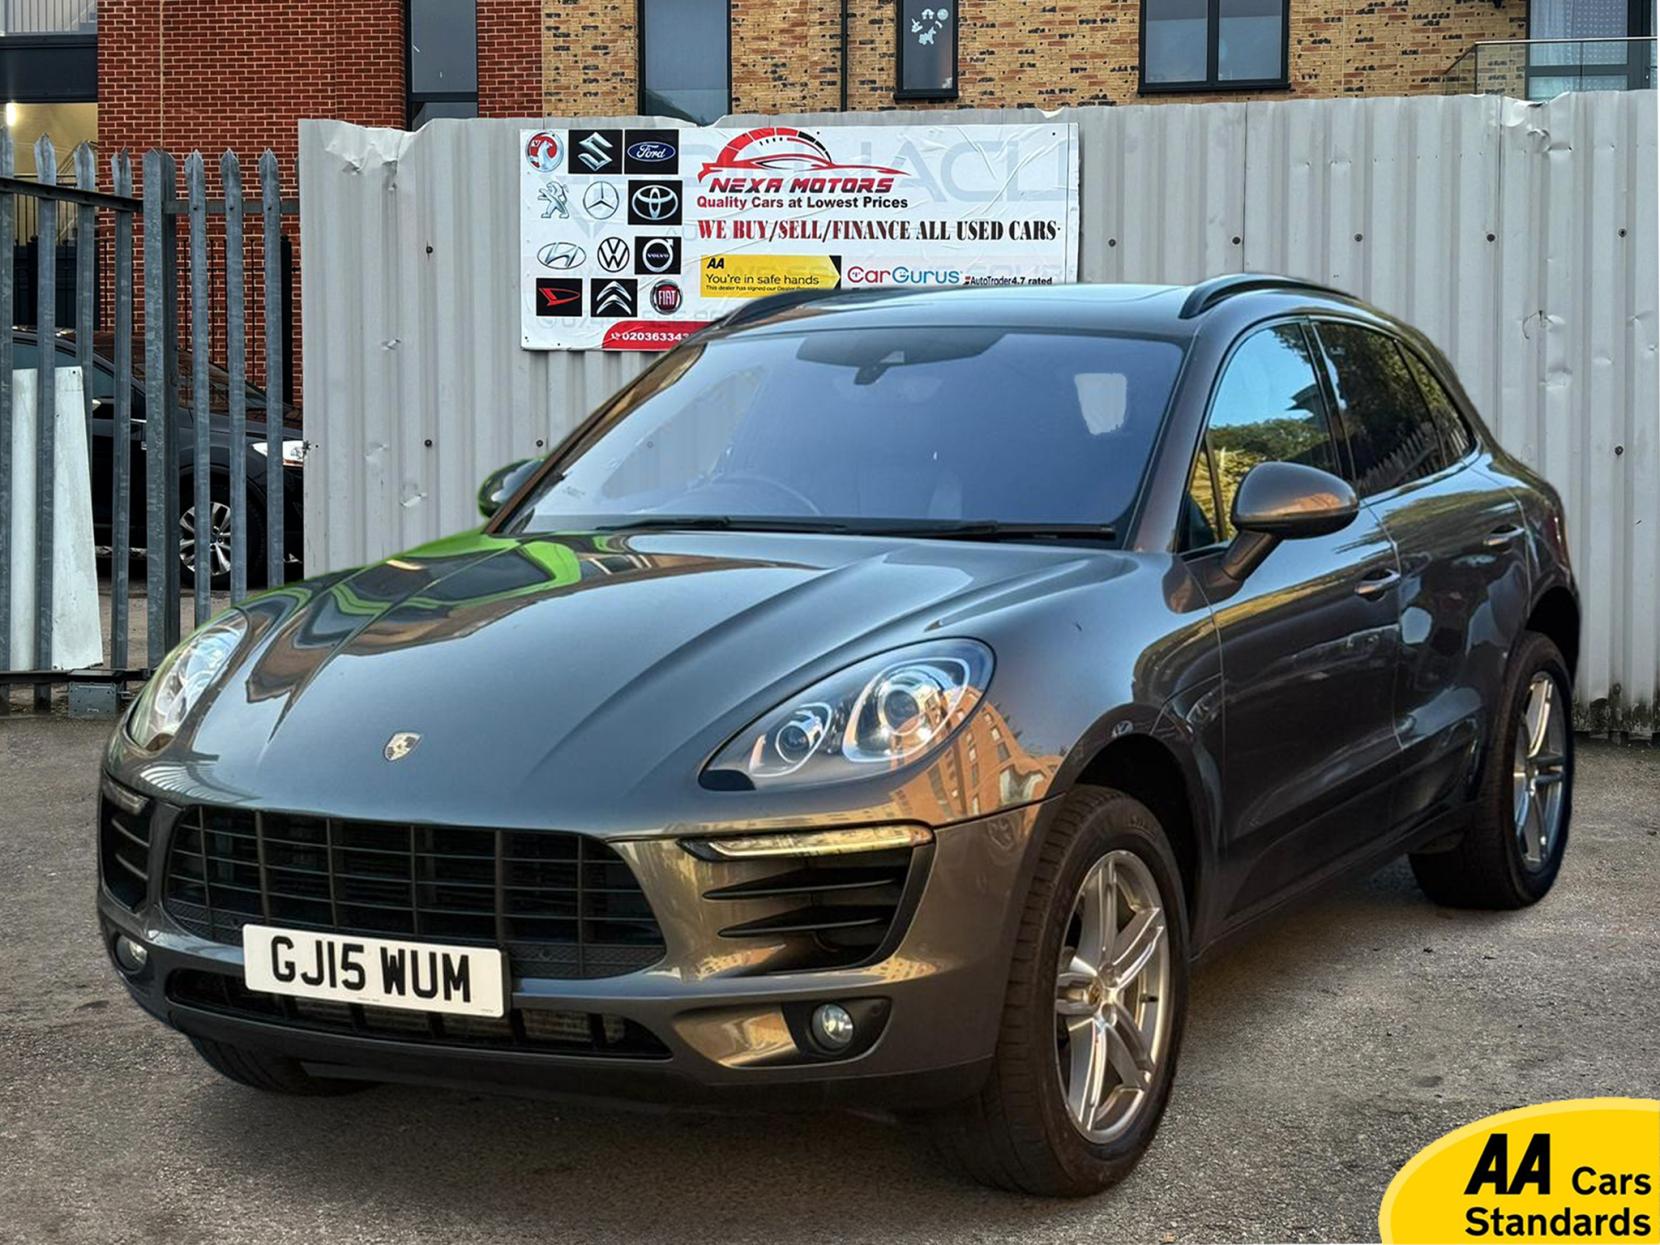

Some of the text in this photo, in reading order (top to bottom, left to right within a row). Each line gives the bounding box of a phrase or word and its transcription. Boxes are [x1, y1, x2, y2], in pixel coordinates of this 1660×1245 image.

[636, 144, 667, 159] Ford
[709, 177, 895, 194] NEXA MOTORS
[697, 195, 908, 211] Quality Cars at Lowest Prices
[698, 219, 727, 240] WE
[915, 220, 951, 241] ALL
[956, 220, 1004, 241] USED
[1008, 220, 1057, 241] CARS
[707, 257, 725, 270] AA
[705, 273, 820, 285] You're in safe hands
[847, 266, 960, 284] CarGurus
[1027, 277, 1053, 285] rated
[658, 290, 677, 306] FIAT
[270, 935, 471, 1003] GJ15 WUM
